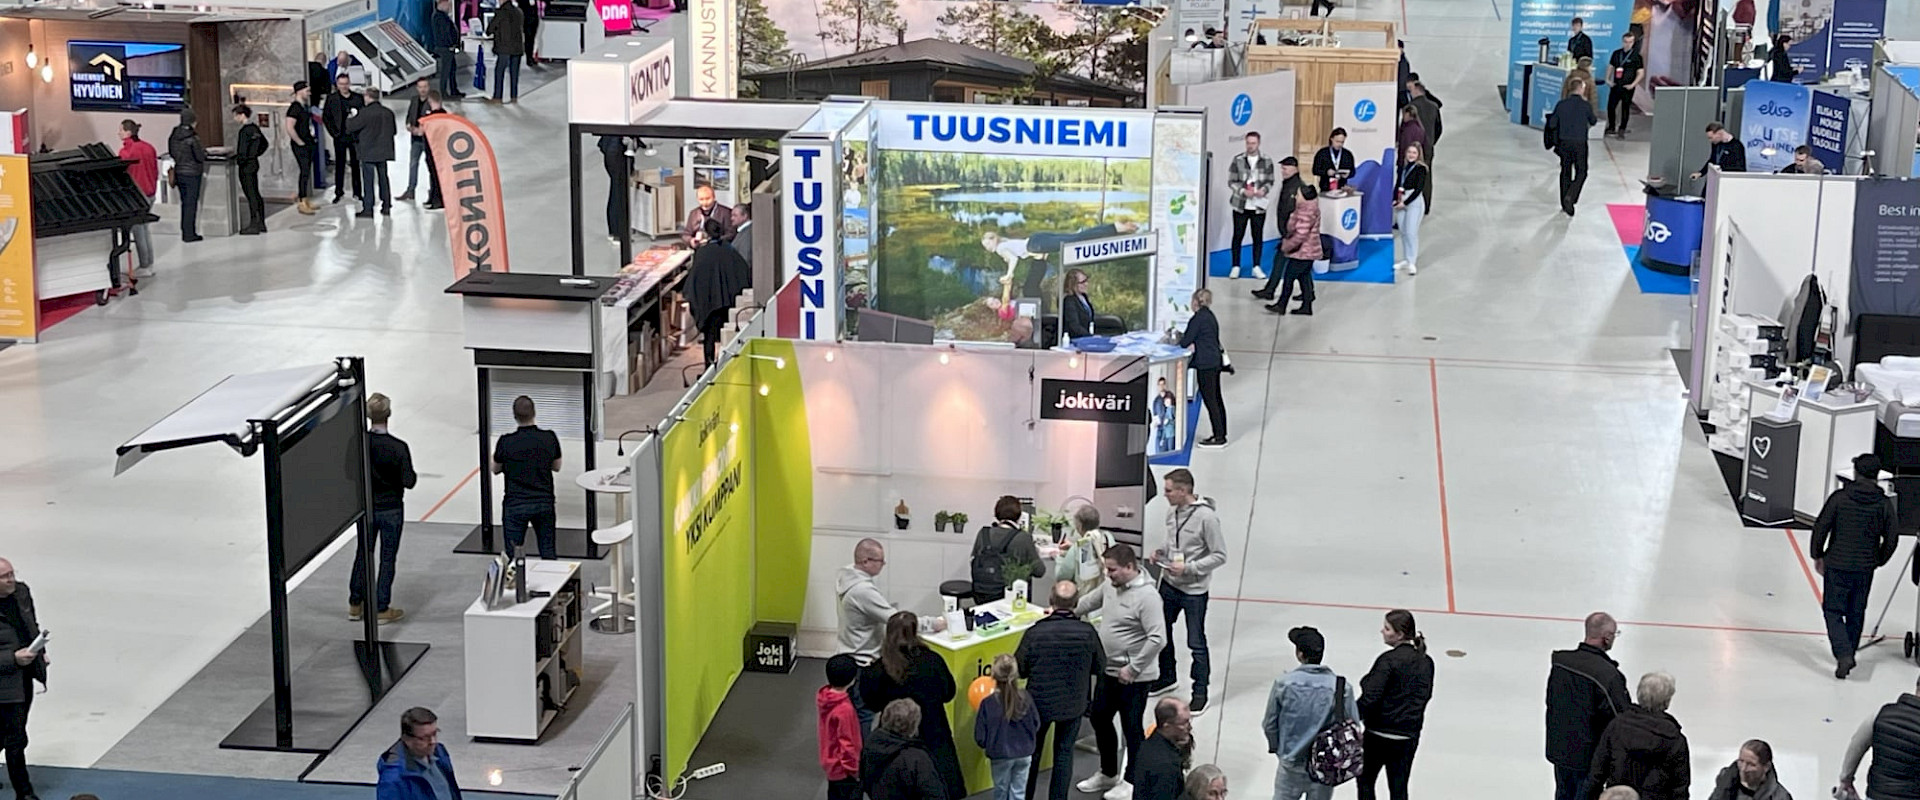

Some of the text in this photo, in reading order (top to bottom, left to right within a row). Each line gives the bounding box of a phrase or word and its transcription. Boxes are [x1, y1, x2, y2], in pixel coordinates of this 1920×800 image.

[602, 5, 628, 20] DNA
[631, 55, 671, 106] KONTIO
[73, 82, 123, 99] HYVÖNEN
[1758, 100, 1793, 118] elisa
[907, 114, 1127, 147] TUUSNIEMI
[1878, 204, 1906, 216] Best
[1074, 237, 1147, 260] TUUSNIEMI
[1055, 389, 1131, 411] jokiväri
[756, 642, 784, 656] joki
[758, 655, 783, 667] väri
